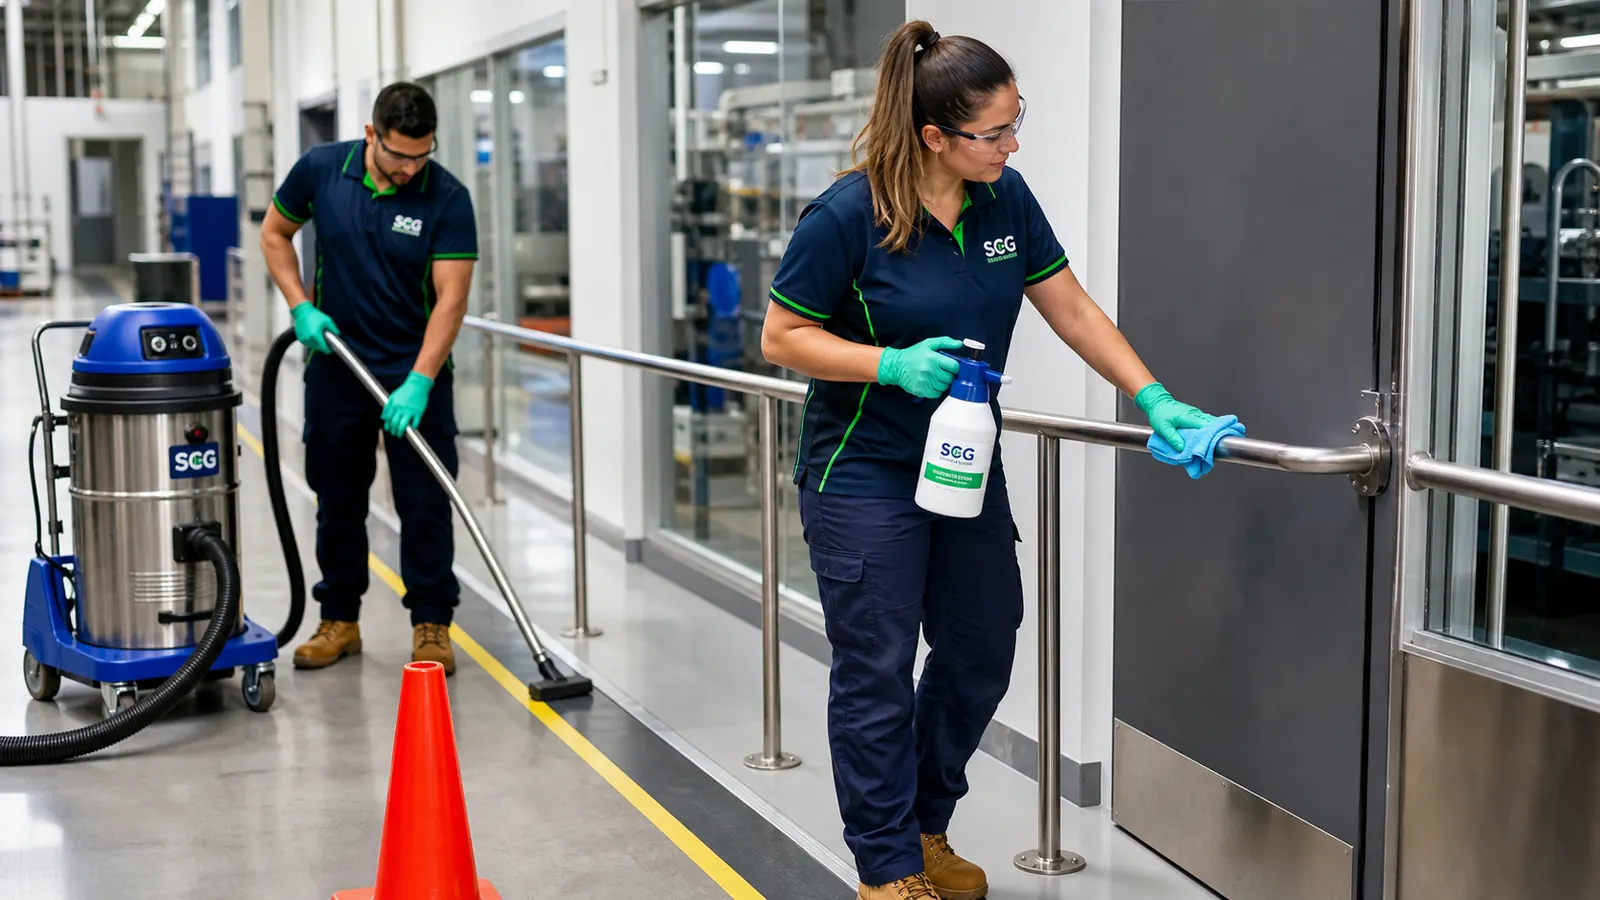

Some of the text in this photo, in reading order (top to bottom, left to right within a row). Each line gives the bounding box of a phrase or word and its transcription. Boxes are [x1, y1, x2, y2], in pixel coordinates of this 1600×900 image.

[393, 214, 423, 232] SCG
[983, 235, 1017, 257] SCG
[174, 449, 217, 472] SCG
[940, 442, 975, 461] SCG
